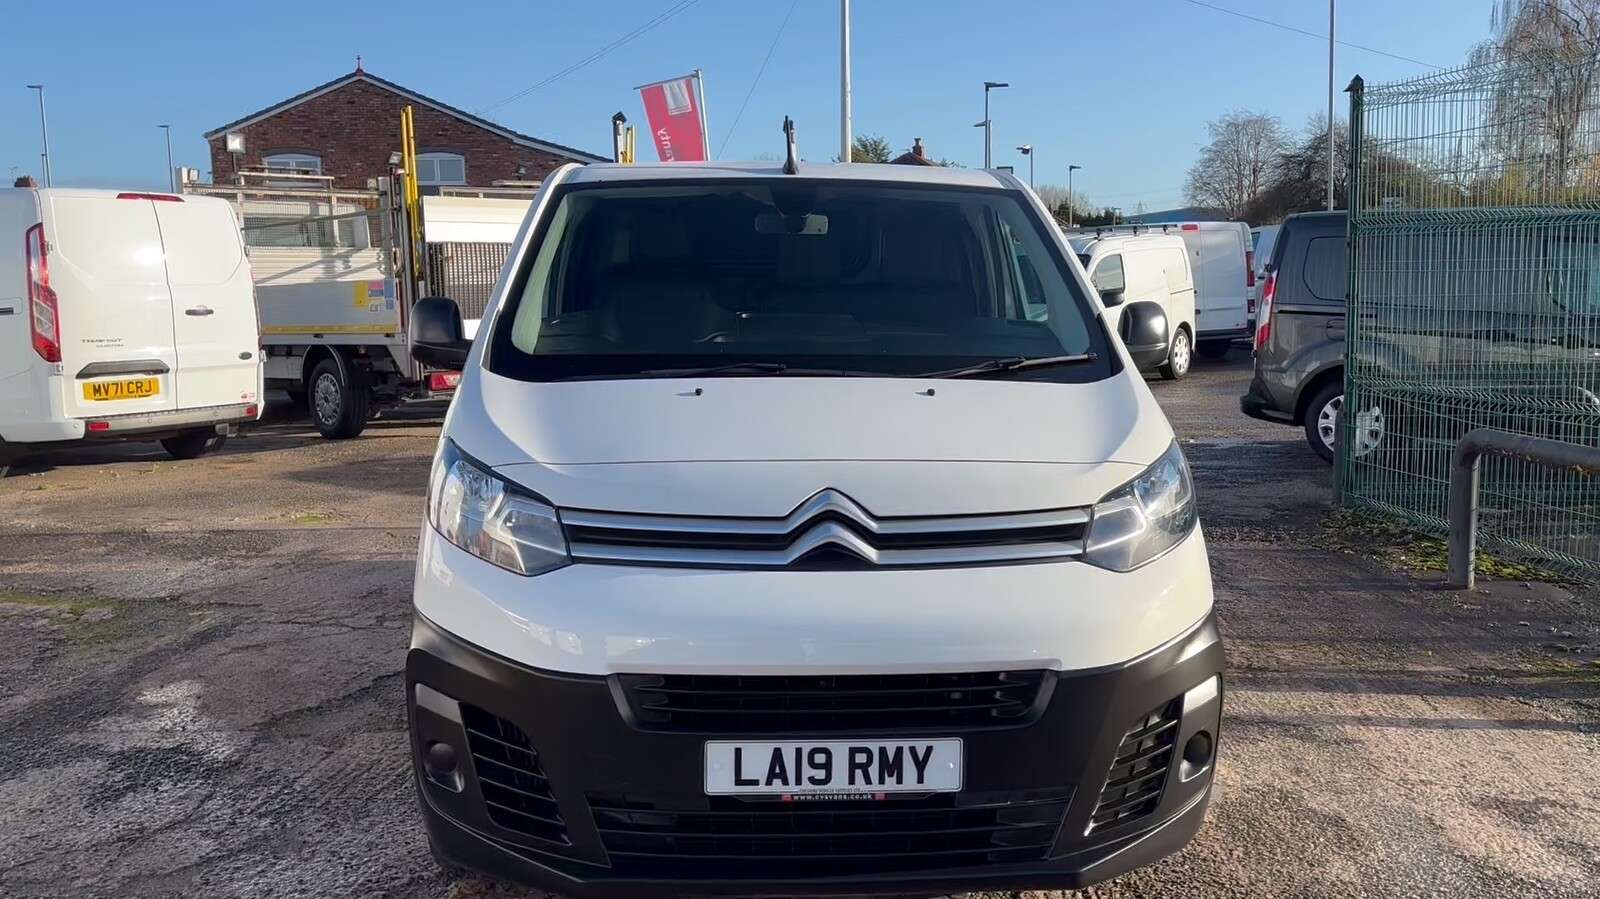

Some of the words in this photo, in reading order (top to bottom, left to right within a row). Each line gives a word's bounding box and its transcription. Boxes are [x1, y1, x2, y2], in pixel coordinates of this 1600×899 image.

[92, 382, 124, 397] MV71
[127, 380, 153, 394] CRJ
[734, 747, 833, 786] LA19
[848, 745, 933, 785] RMY
